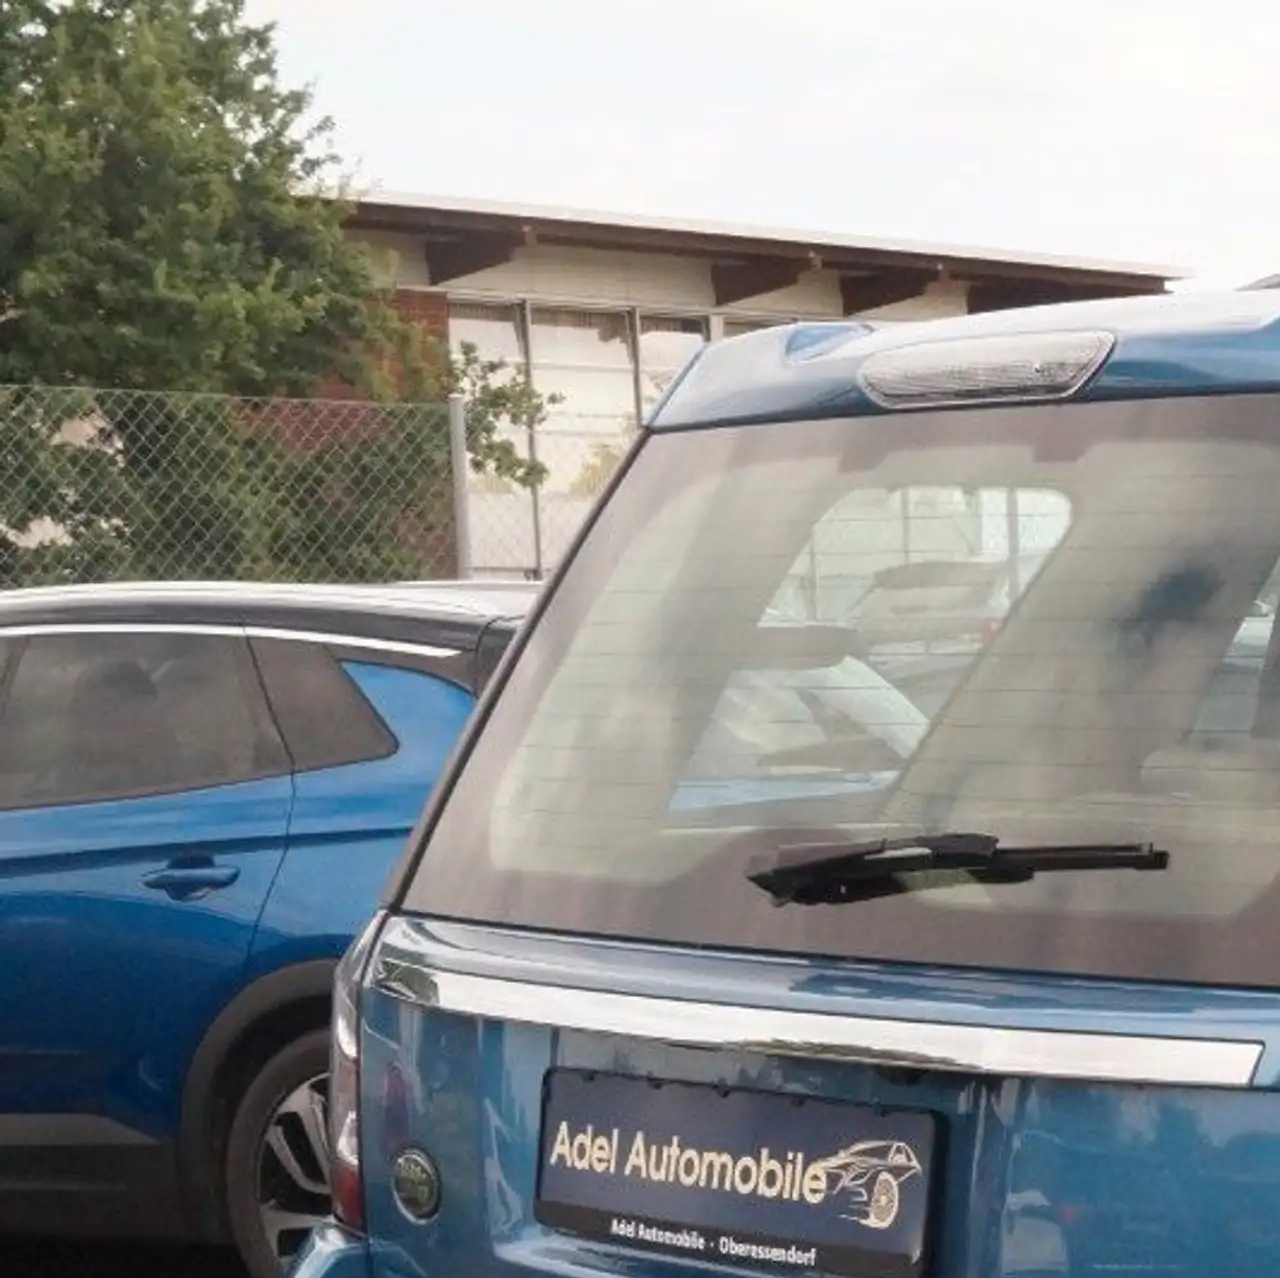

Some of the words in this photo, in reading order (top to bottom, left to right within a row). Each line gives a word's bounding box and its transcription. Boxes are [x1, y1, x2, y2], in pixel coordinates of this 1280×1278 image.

[550, 1120, 619, 1174] Adel
[624, 1130, 827, 1204] Automobile
[611, 1218, 635, 1238] Adel
[638, 1223, 705, 1250] Automobile
